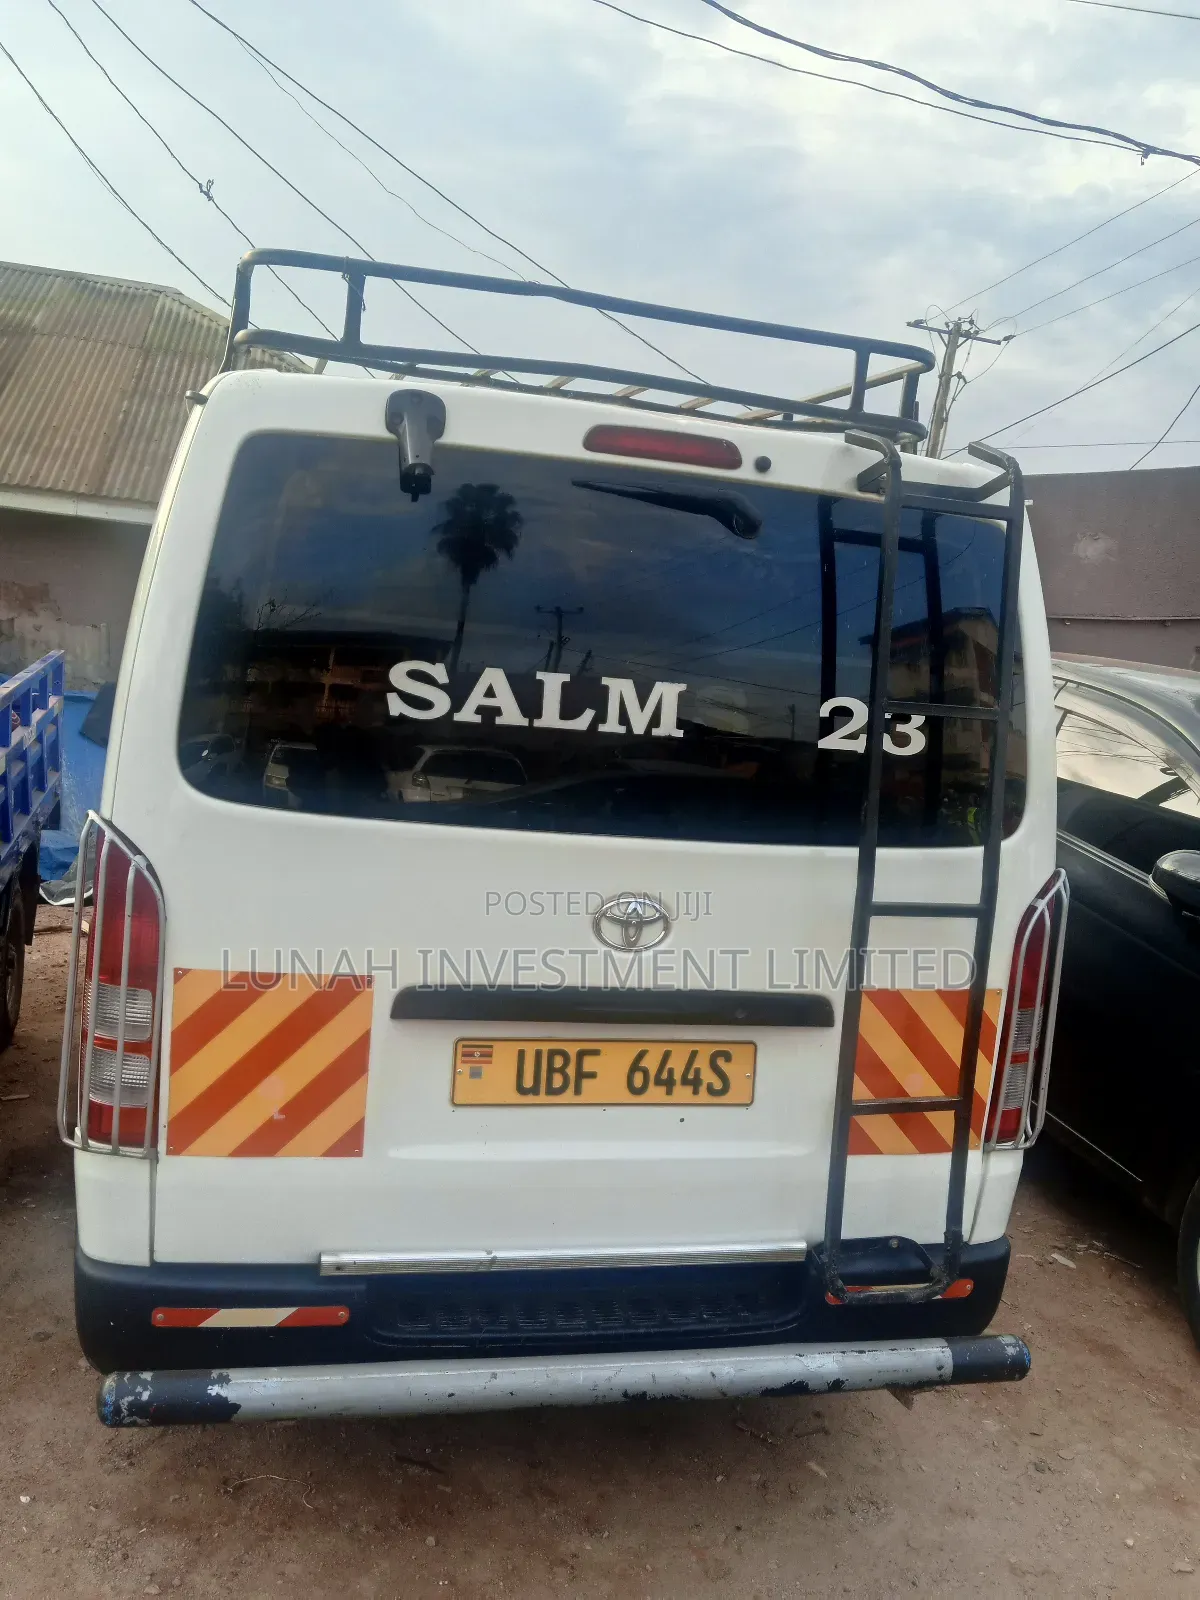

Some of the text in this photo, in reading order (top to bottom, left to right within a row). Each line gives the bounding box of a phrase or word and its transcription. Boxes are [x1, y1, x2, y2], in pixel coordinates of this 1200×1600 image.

[387, 659, 927, 756] SALM 23
[515, 1048, 733, 1097] UBF 644S
